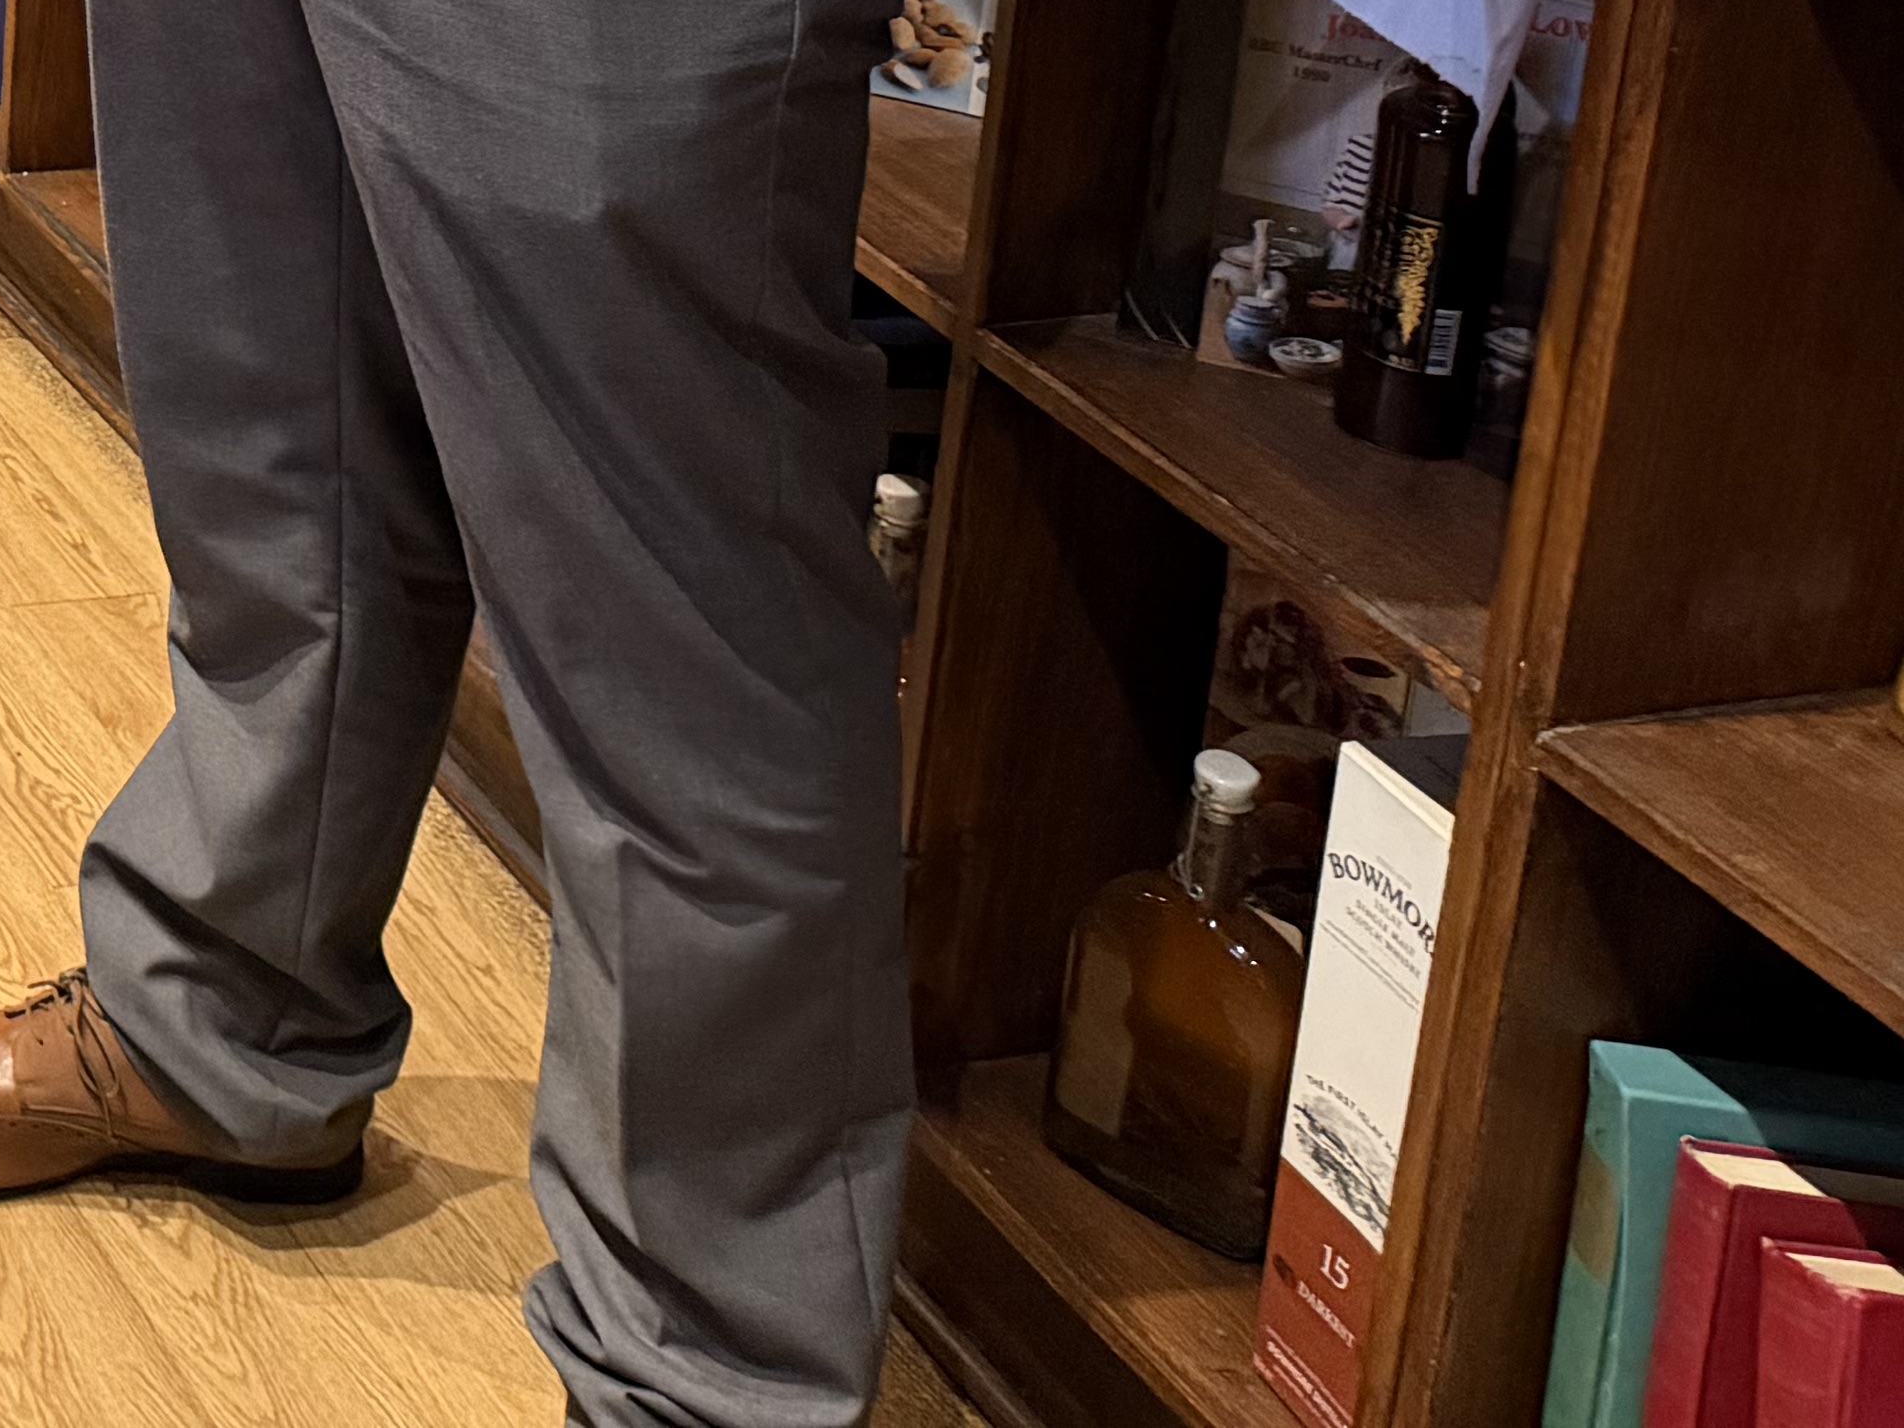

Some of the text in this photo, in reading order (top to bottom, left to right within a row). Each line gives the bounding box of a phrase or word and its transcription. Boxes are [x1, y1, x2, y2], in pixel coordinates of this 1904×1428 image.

[1289, 44, 1383, 70] MasterChef
[1327, 1083, 1355, 1111] FIRST
[1320, 1244, 1350, 1289] 15
